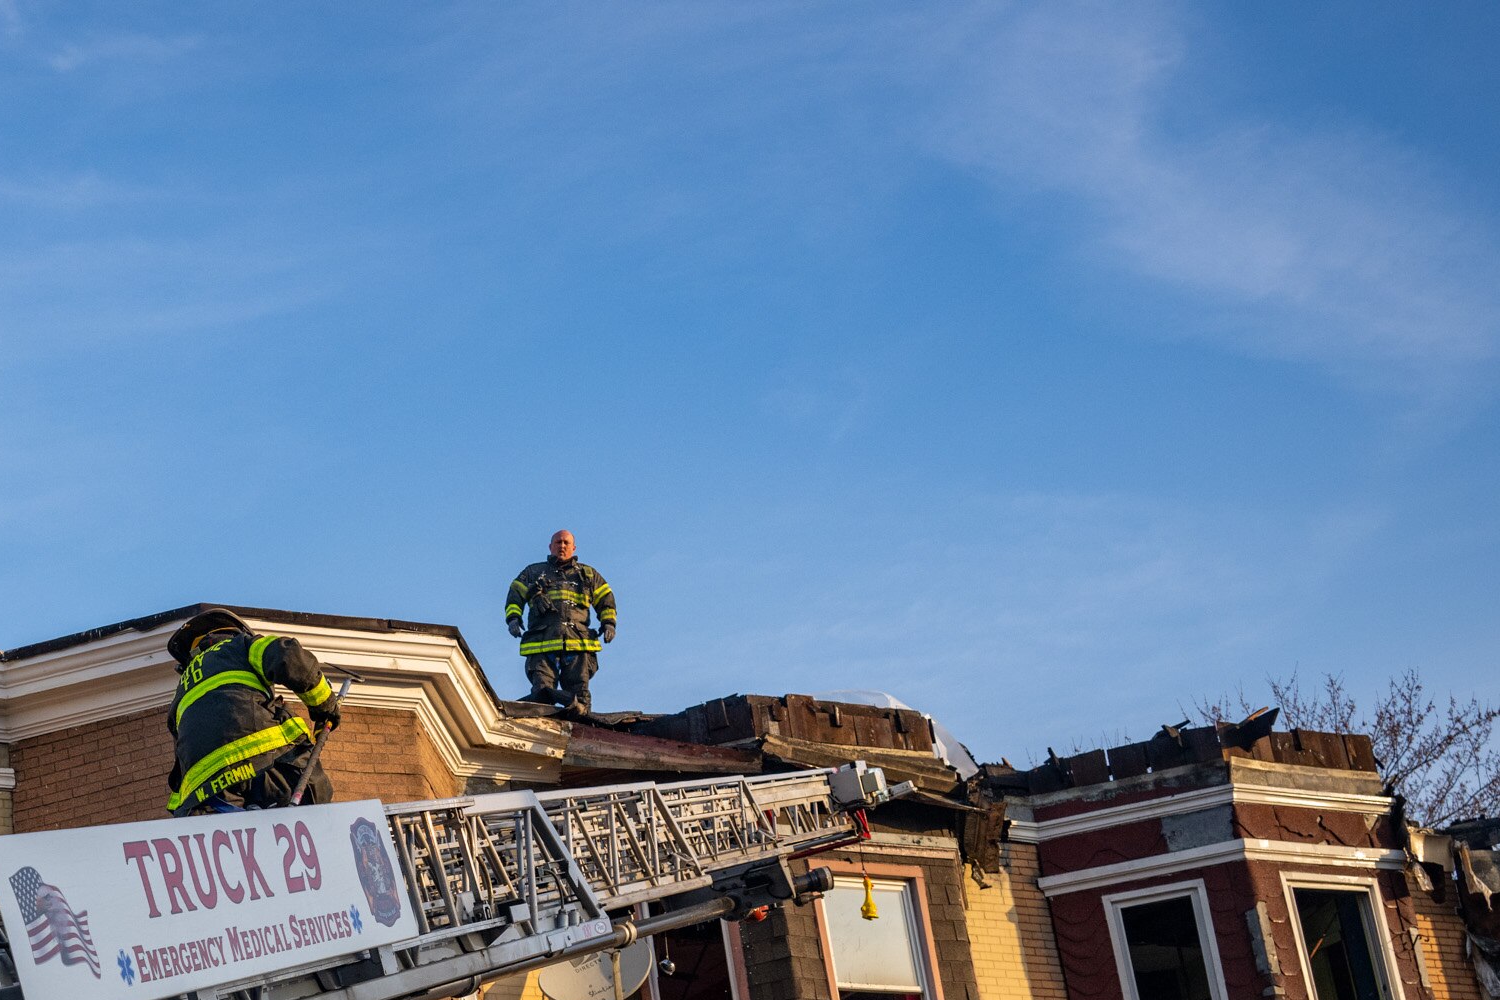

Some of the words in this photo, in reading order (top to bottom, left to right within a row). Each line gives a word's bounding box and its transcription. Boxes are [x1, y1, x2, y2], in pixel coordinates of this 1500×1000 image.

[195, 787, 209, 802] W.
[210, 762, 256, 794] FERMIN
[123, 828, 274, 918] TRUCK
[272, 820, 322, 893] 29
[132, 936, 227, 983] EMERGENCY
[225, 923, 292, 962] MEDICAL
[288, 910, 351, 948] SERVICES
